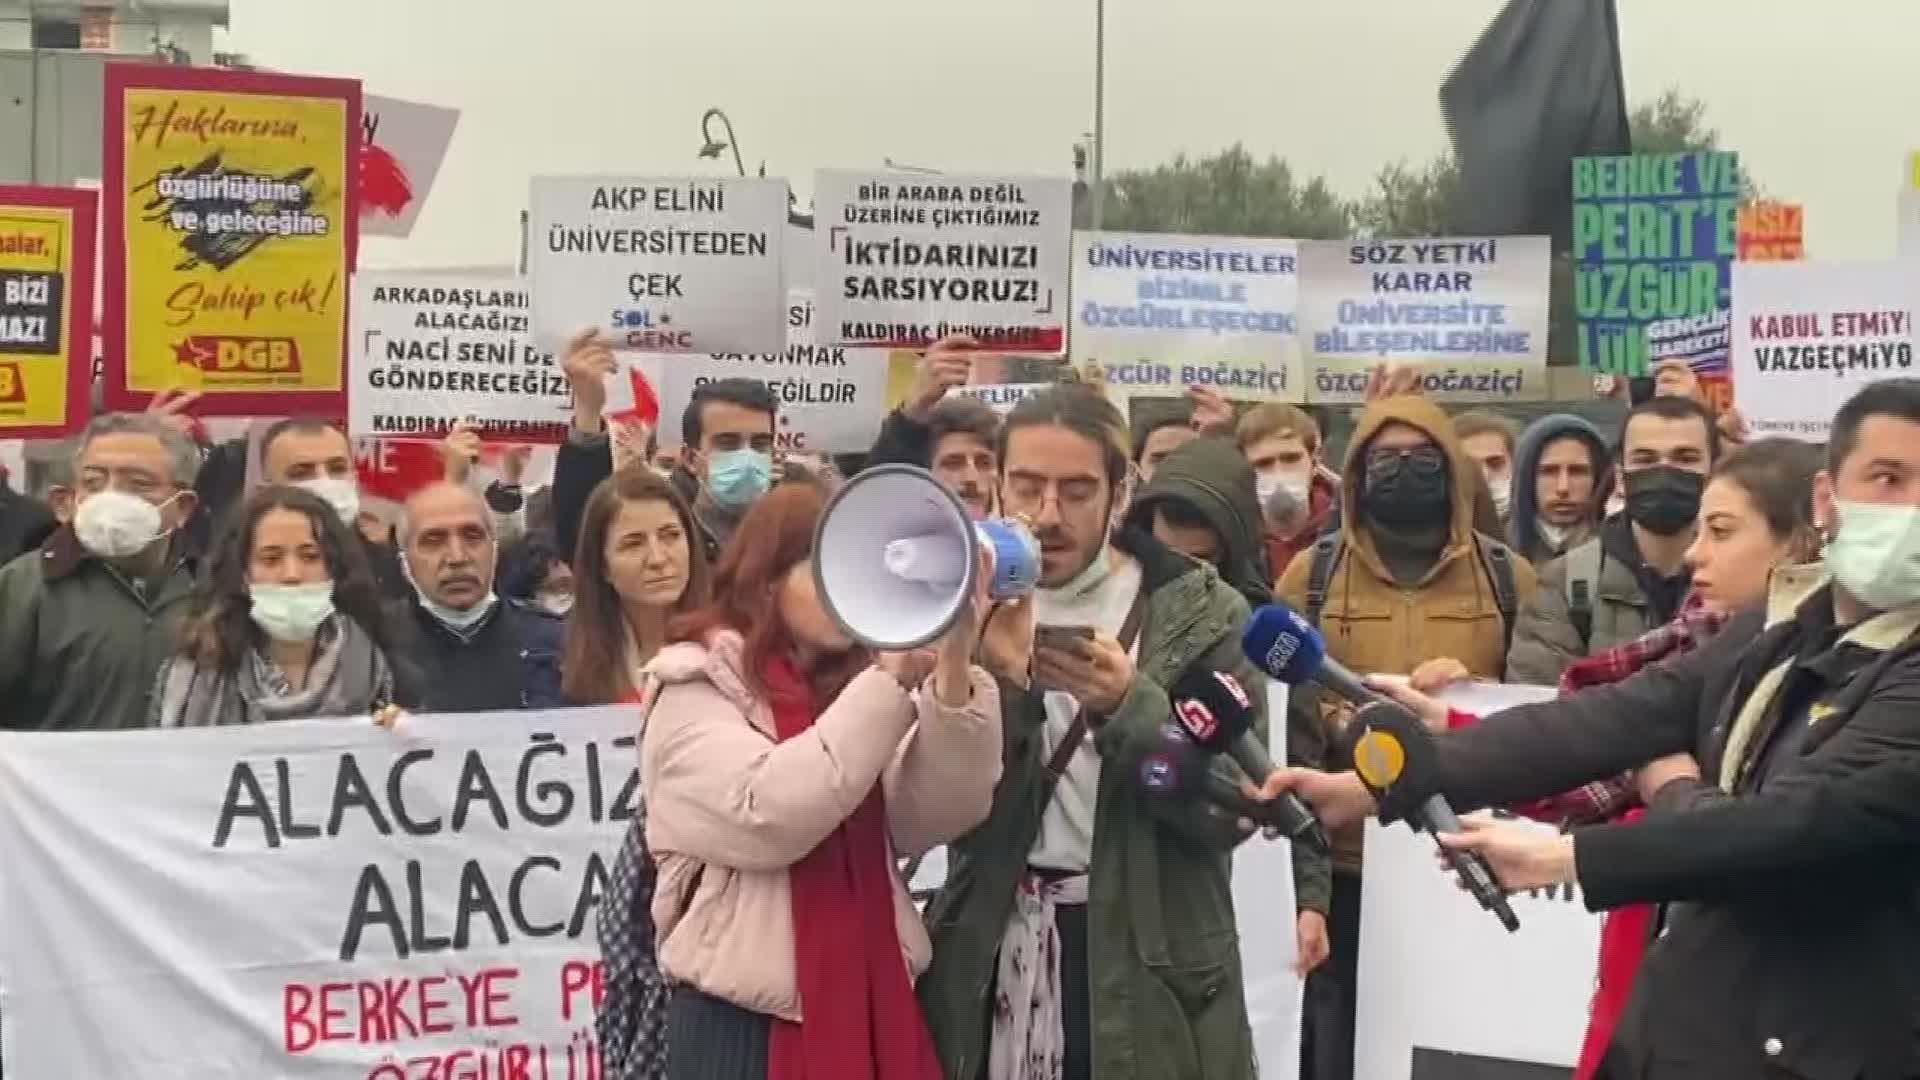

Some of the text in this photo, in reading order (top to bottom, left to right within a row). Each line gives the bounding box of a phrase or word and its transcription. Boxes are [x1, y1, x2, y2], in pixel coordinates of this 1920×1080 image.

[157, 173, 302, 204] özgürlüğüne
[1573, 151, 1739, 197] BERKE VE
[592, 182, 724, 211] AKP ELİNİ
[858, 181, 1026, 204] BİR ARABA DEĞİL
[170, 209, 329, 238] ve geleceğine
[844, 204, 1040, 228] ÜZERİNE ÇIKTIĞIMIZ
[549, 224, 766, 256] ÜNİVERSİTEDEN
[845, 236, 1038, 268] İKTİDARINIZI
[1350, 239, 1497, 264] SÖZ YETKİ
[1087, 243, 1296, 273] ÜNİVERSİTELER
[5, 276, 48, 305] BİZİ
[628, 272, 683, 301] ÇEK
[844, 276, 1038, 302] SARSIYORUZ!
[1372, 271, 1473, 292] KARAR
[373, 286, 529, 310] ARKADAŞLARI
[414, 310, 529, 332] ALACAĞIZ!
[1751, 310, 1911, 340] KABUL ETMİY
[217, 340, 290, 370] DGB
[386, 337, 449, 361] NACİ
[457, 340, 515, 365] SENİ
[1313, 328, 1531, 355] BİLEŞENLERİNE
[369, 366, 571, 396] GÖNDERECEĞİZ!
[1181, 363, 1288, 391] BOĞAZİÇİ
[1412, 369, 1524, 395] OĞAZİÇİ
